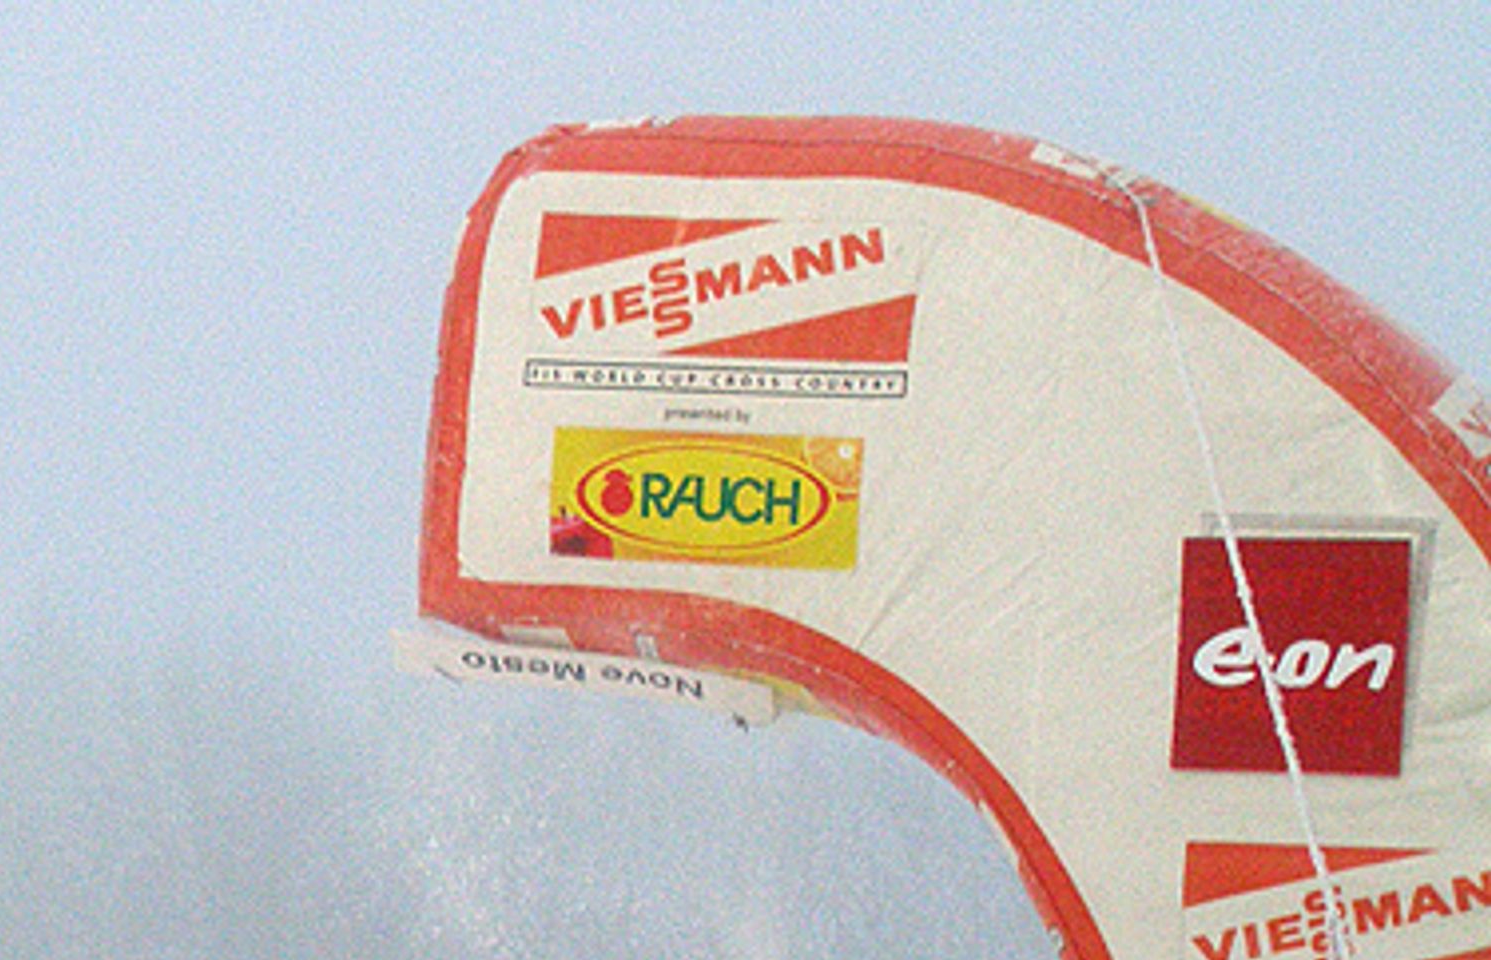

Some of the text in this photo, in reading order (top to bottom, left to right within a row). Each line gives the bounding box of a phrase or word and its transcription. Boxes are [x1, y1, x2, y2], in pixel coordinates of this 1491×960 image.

[541, 228, 886, 339] VIESSMANN
[573, 370, 646, 384] WORLD
[657, 372, 697, 386] CUP
[710, 373, 781, 388] CROSS
[794, 376, 896, 391] COUNTRY
[641, 472, 801, 525] RAUCH
[461, 650, 704, 699] Nove Mesto
